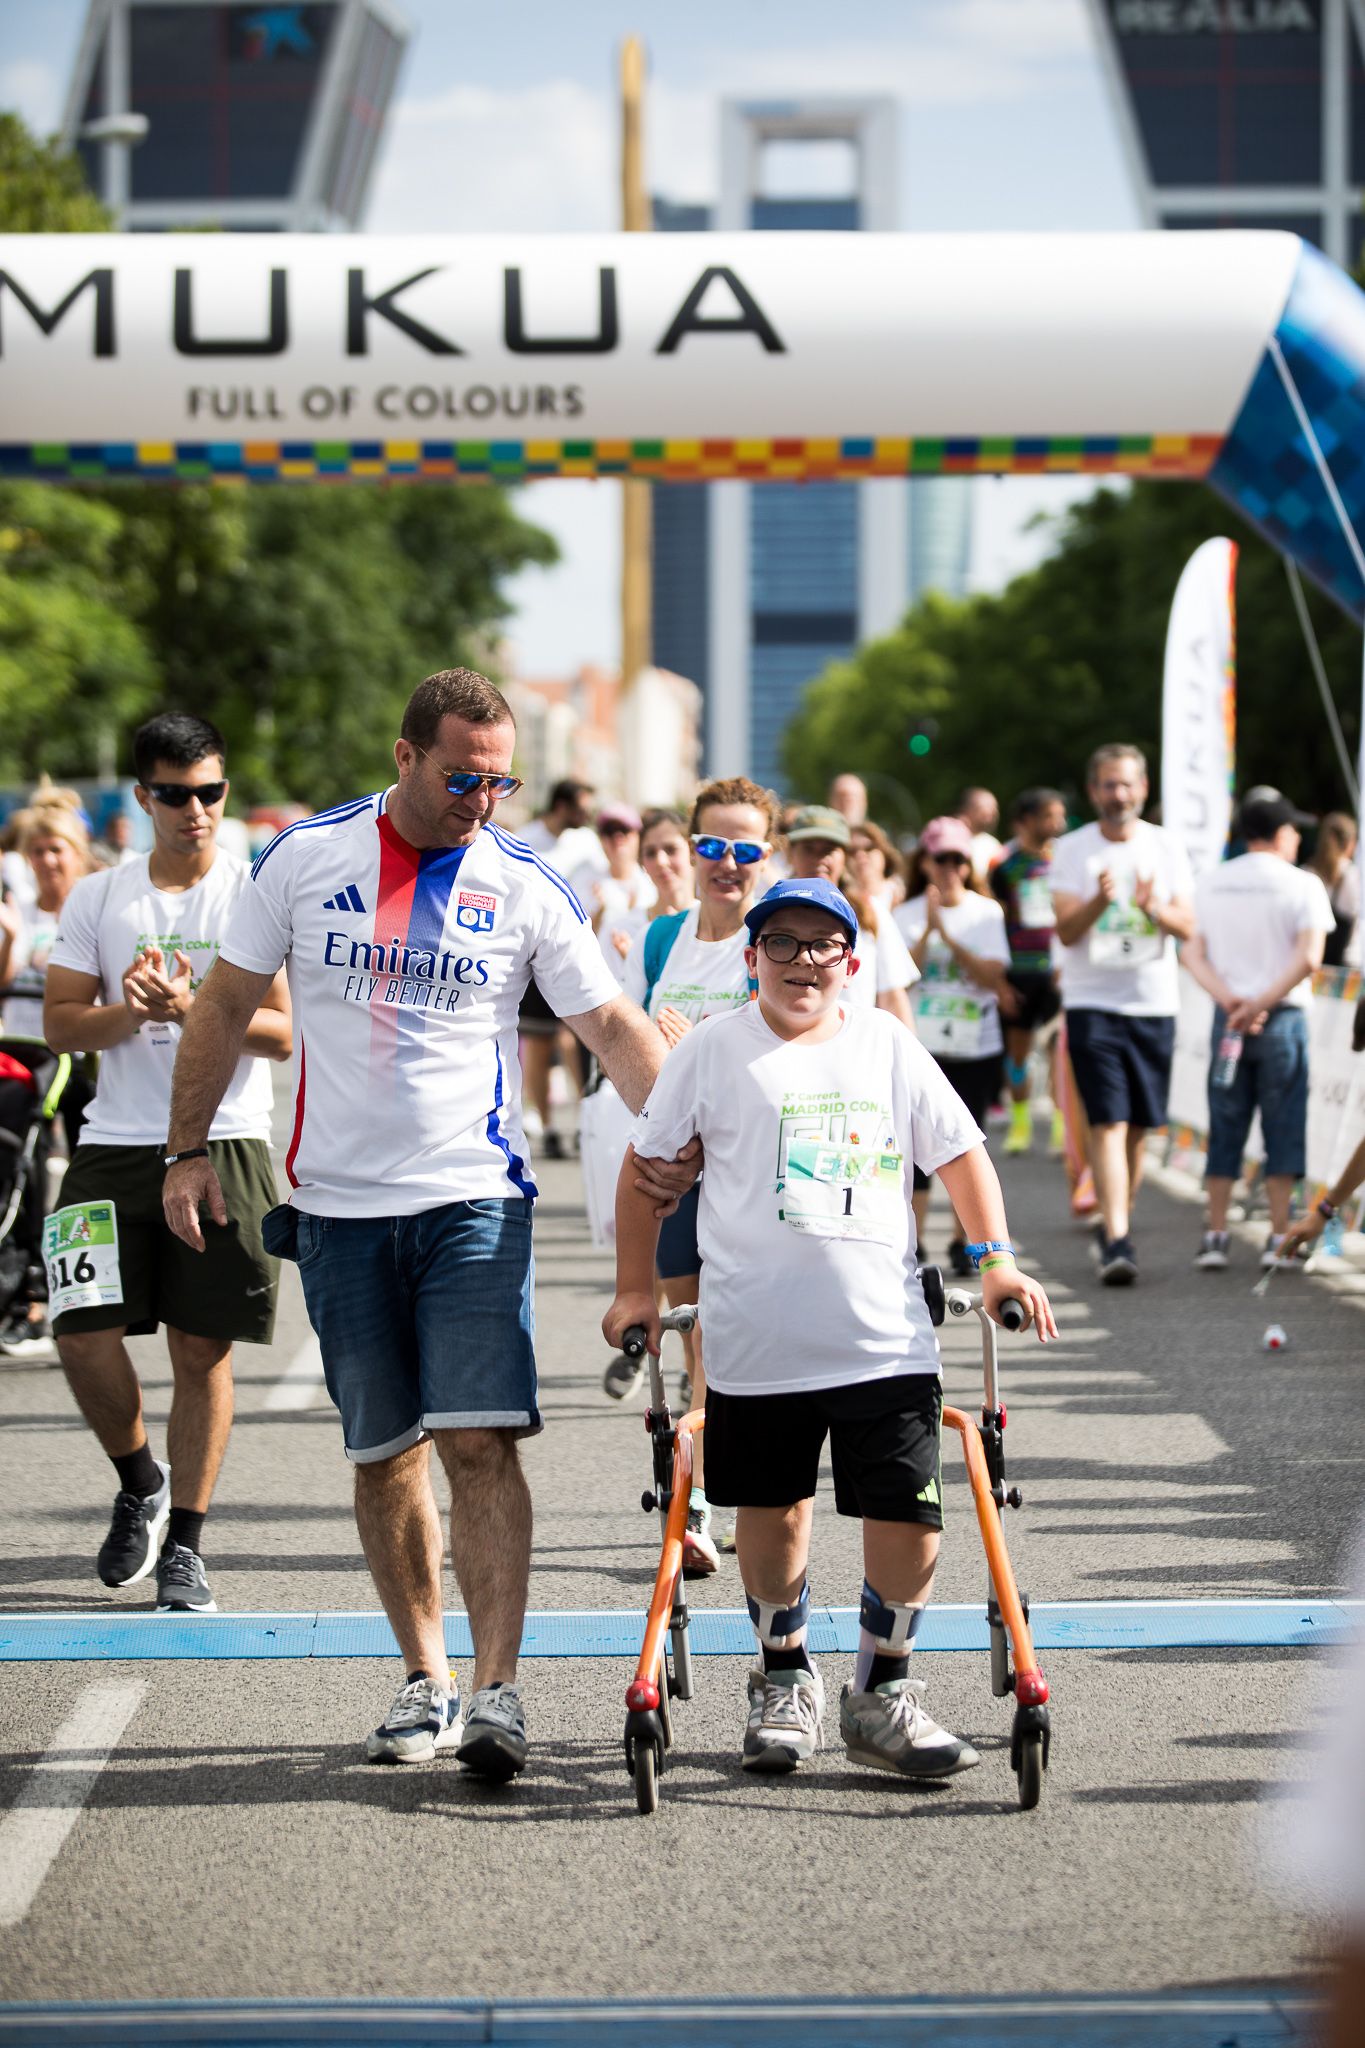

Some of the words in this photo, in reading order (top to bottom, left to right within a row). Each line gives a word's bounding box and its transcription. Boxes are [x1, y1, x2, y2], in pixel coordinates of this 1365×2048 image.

[187, 385, 286, 421] FULL
[300, 384, 359, 421] OF
[373, 384, 584, 421] COLOURS
[459, 907, 490, 929] OL
[185, 940, 211, 950] CON
[324, 931, 489, 986] Emirates
[344, 976, 379, 1001] FLY
[384, 979, 460, 1013] BETTER
[782, 1102, 845, 1115] MADRID
[849, 1101, 878, 1113] CON
[798, 1091, 840, 1101] Carrera
[842, 1187, 853, 1216] 1
